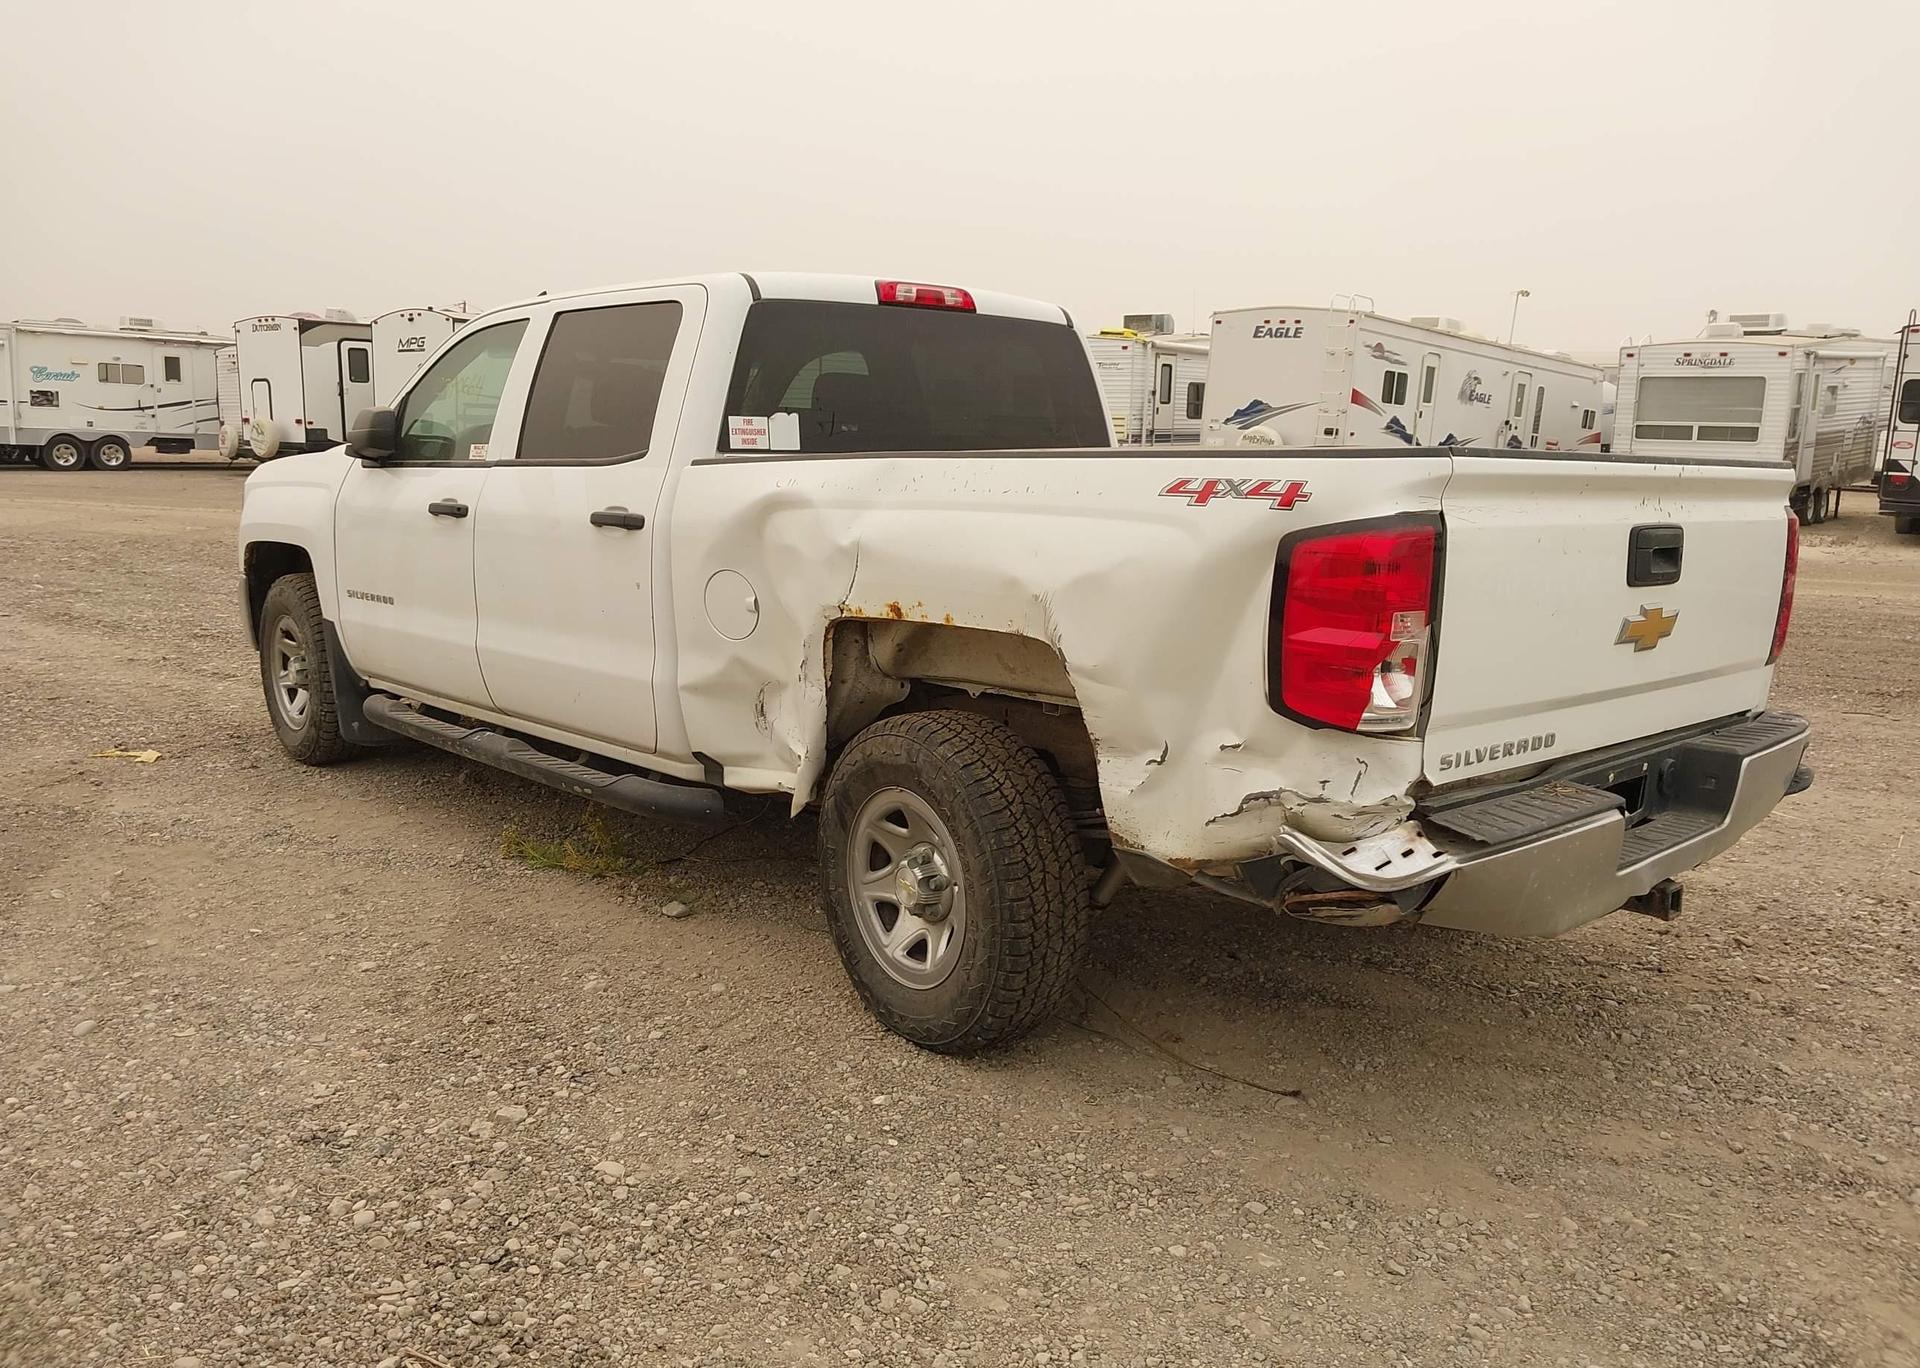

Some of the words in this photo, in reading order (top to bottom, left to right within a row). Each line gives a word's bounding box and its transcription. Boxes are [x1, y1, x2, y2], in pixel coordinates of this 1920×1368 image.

[1252, 325, 1304, 339] EAGLE
[397, 336, 426, 348] MPG
[1674, 357, 1736, 367] SPRINGDALE
[30, 366, 80, 383] Corsair
[1469, 389, 1492, 405] EAGLE
[742, 418, 754, 426] FIRE
[731, 428, 766, 436] EXTINGUISHER
[741, 438, 757, 446] INSIDE
[346, 589, 395, 606] SILVERADO
[1439, 732, 1556, 772] SILVERADO
